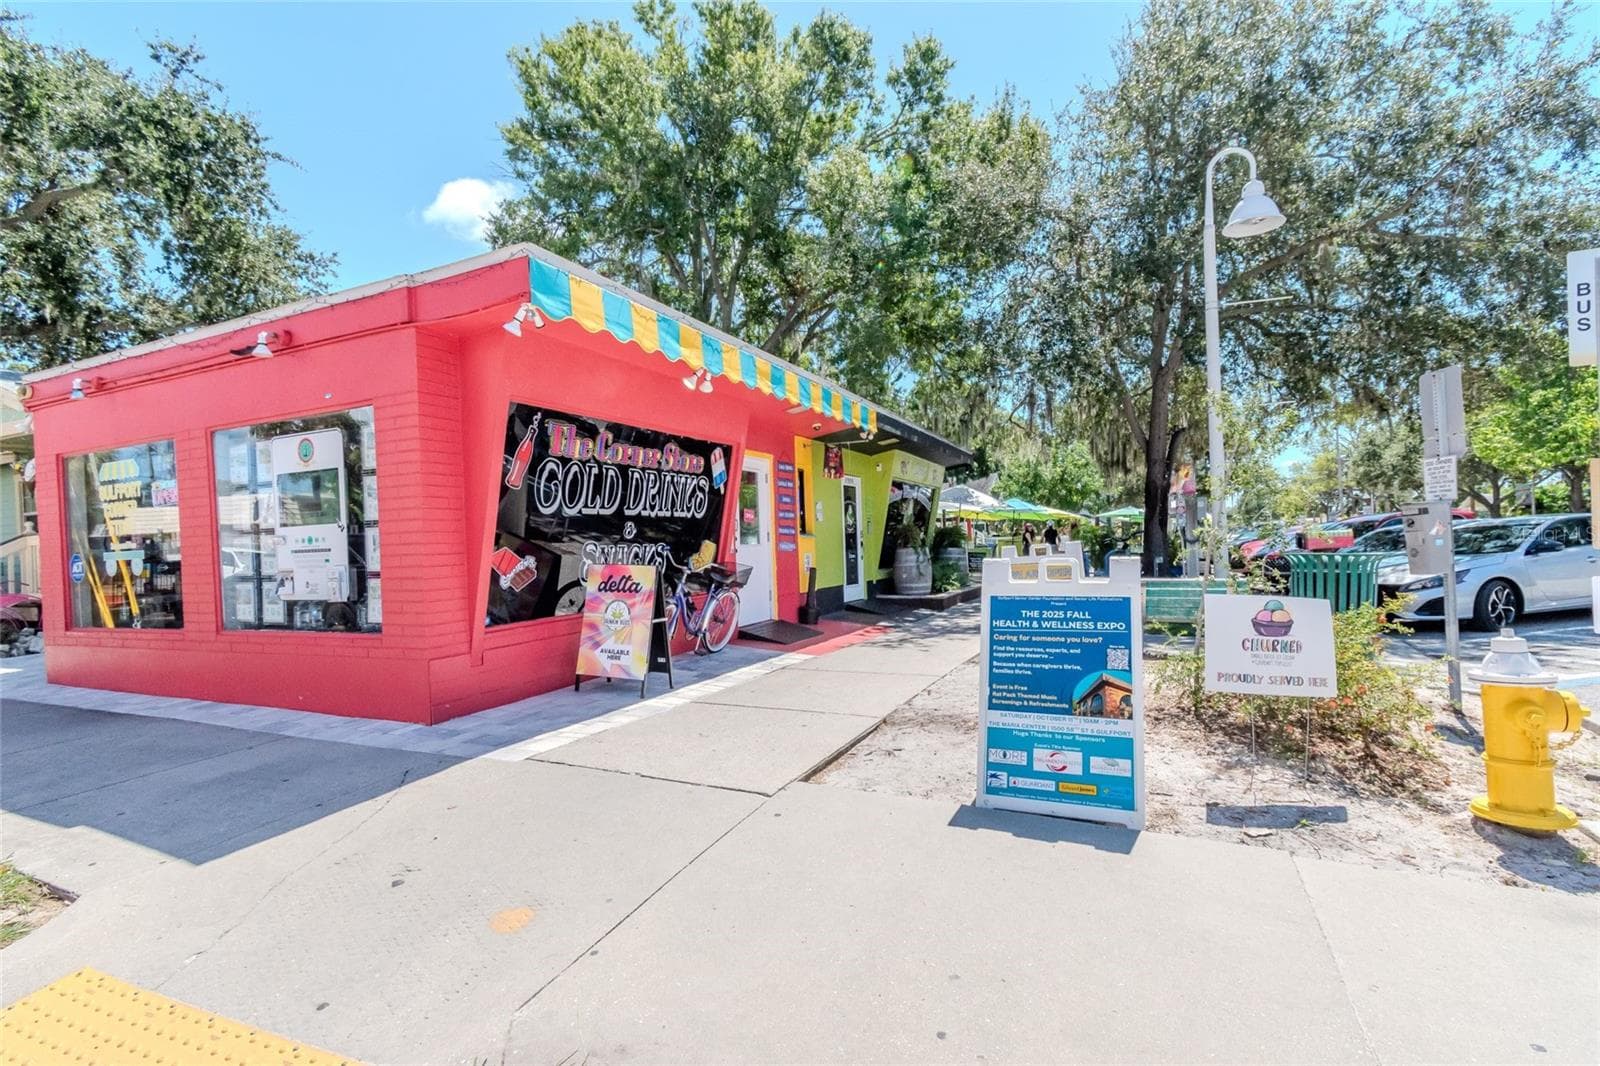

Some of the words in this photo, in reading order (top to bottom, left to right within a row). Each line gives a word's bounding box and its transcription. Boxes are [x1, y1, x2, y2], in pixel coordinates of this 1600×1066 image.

[1577, 282, 1592, 331] BUS
[544, 419, 594, 461] The
[594, 430, 662, 469] Corner
[661, 441, 705, 474] Store
[534, 457, 622, 517] COLD
[623, 467, 710, 519] DRINKS
[598, 574, 643, 594] delta
[1020, 610, 1040, 618] THE
[1042, 610, 1065, 618] 2025
[1066, 611, 1092, 619] FALL
[992, 619, 1030, 628] HEALTH
[1031, 620, 1039, 628] &
[1041, 620, 1095, 629] WELLNESS
[1097, 621, 1126, 630] EXPO
[993, 633, 1018, 642] Caring
[600, 648, 630, 656] AVAILABLE
[1217, 672, 1264, 685] PROUDLY
[1267, 675, 1304, 687] SERVED
[1308, 677, 1329, 688] HERE
[1029, 701, 1069, 709] Refreshments
[1000, 712, 1032, 720] SATURDAY
[1036, 714, 1067, 722] OCTOBER
[1096, 729, 1131, 737] GULFPORT
[1075, 734, 1106, 743] Sponsors
